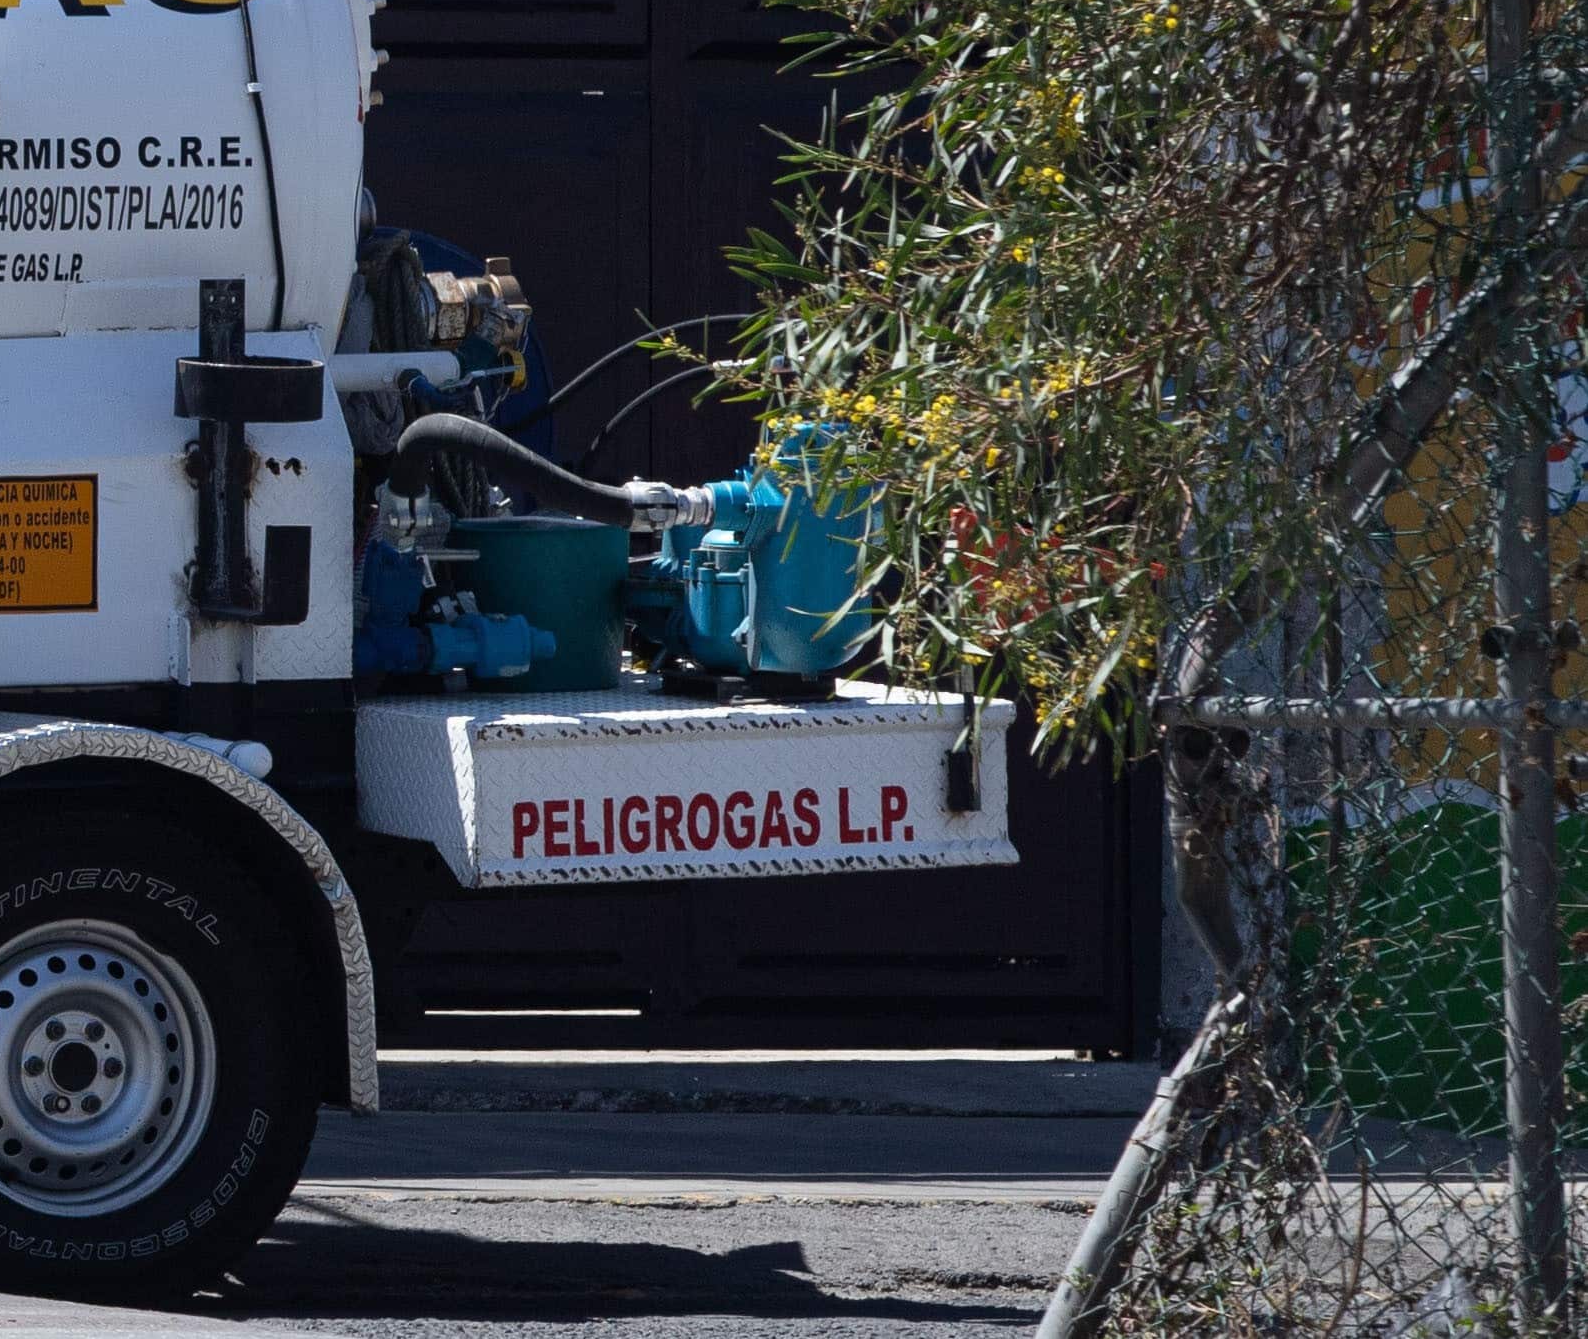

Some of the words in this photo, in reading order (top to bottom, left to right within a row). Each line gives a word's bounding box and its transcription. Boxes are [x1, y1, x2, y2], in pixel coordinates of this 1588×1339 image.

[137, 135, 255, 170] C.R.E.
[9, 253, 49, 282] GAS
[23, 482, 78, 502] QUIMICA
[15, 513, 22, 527] o
[26, 508, 90, 527] accidente
[9, 532, 18, 551] Y
[24, 532, 74, 554] NOCHE)
[838, 785, 916, 845] L.P.
